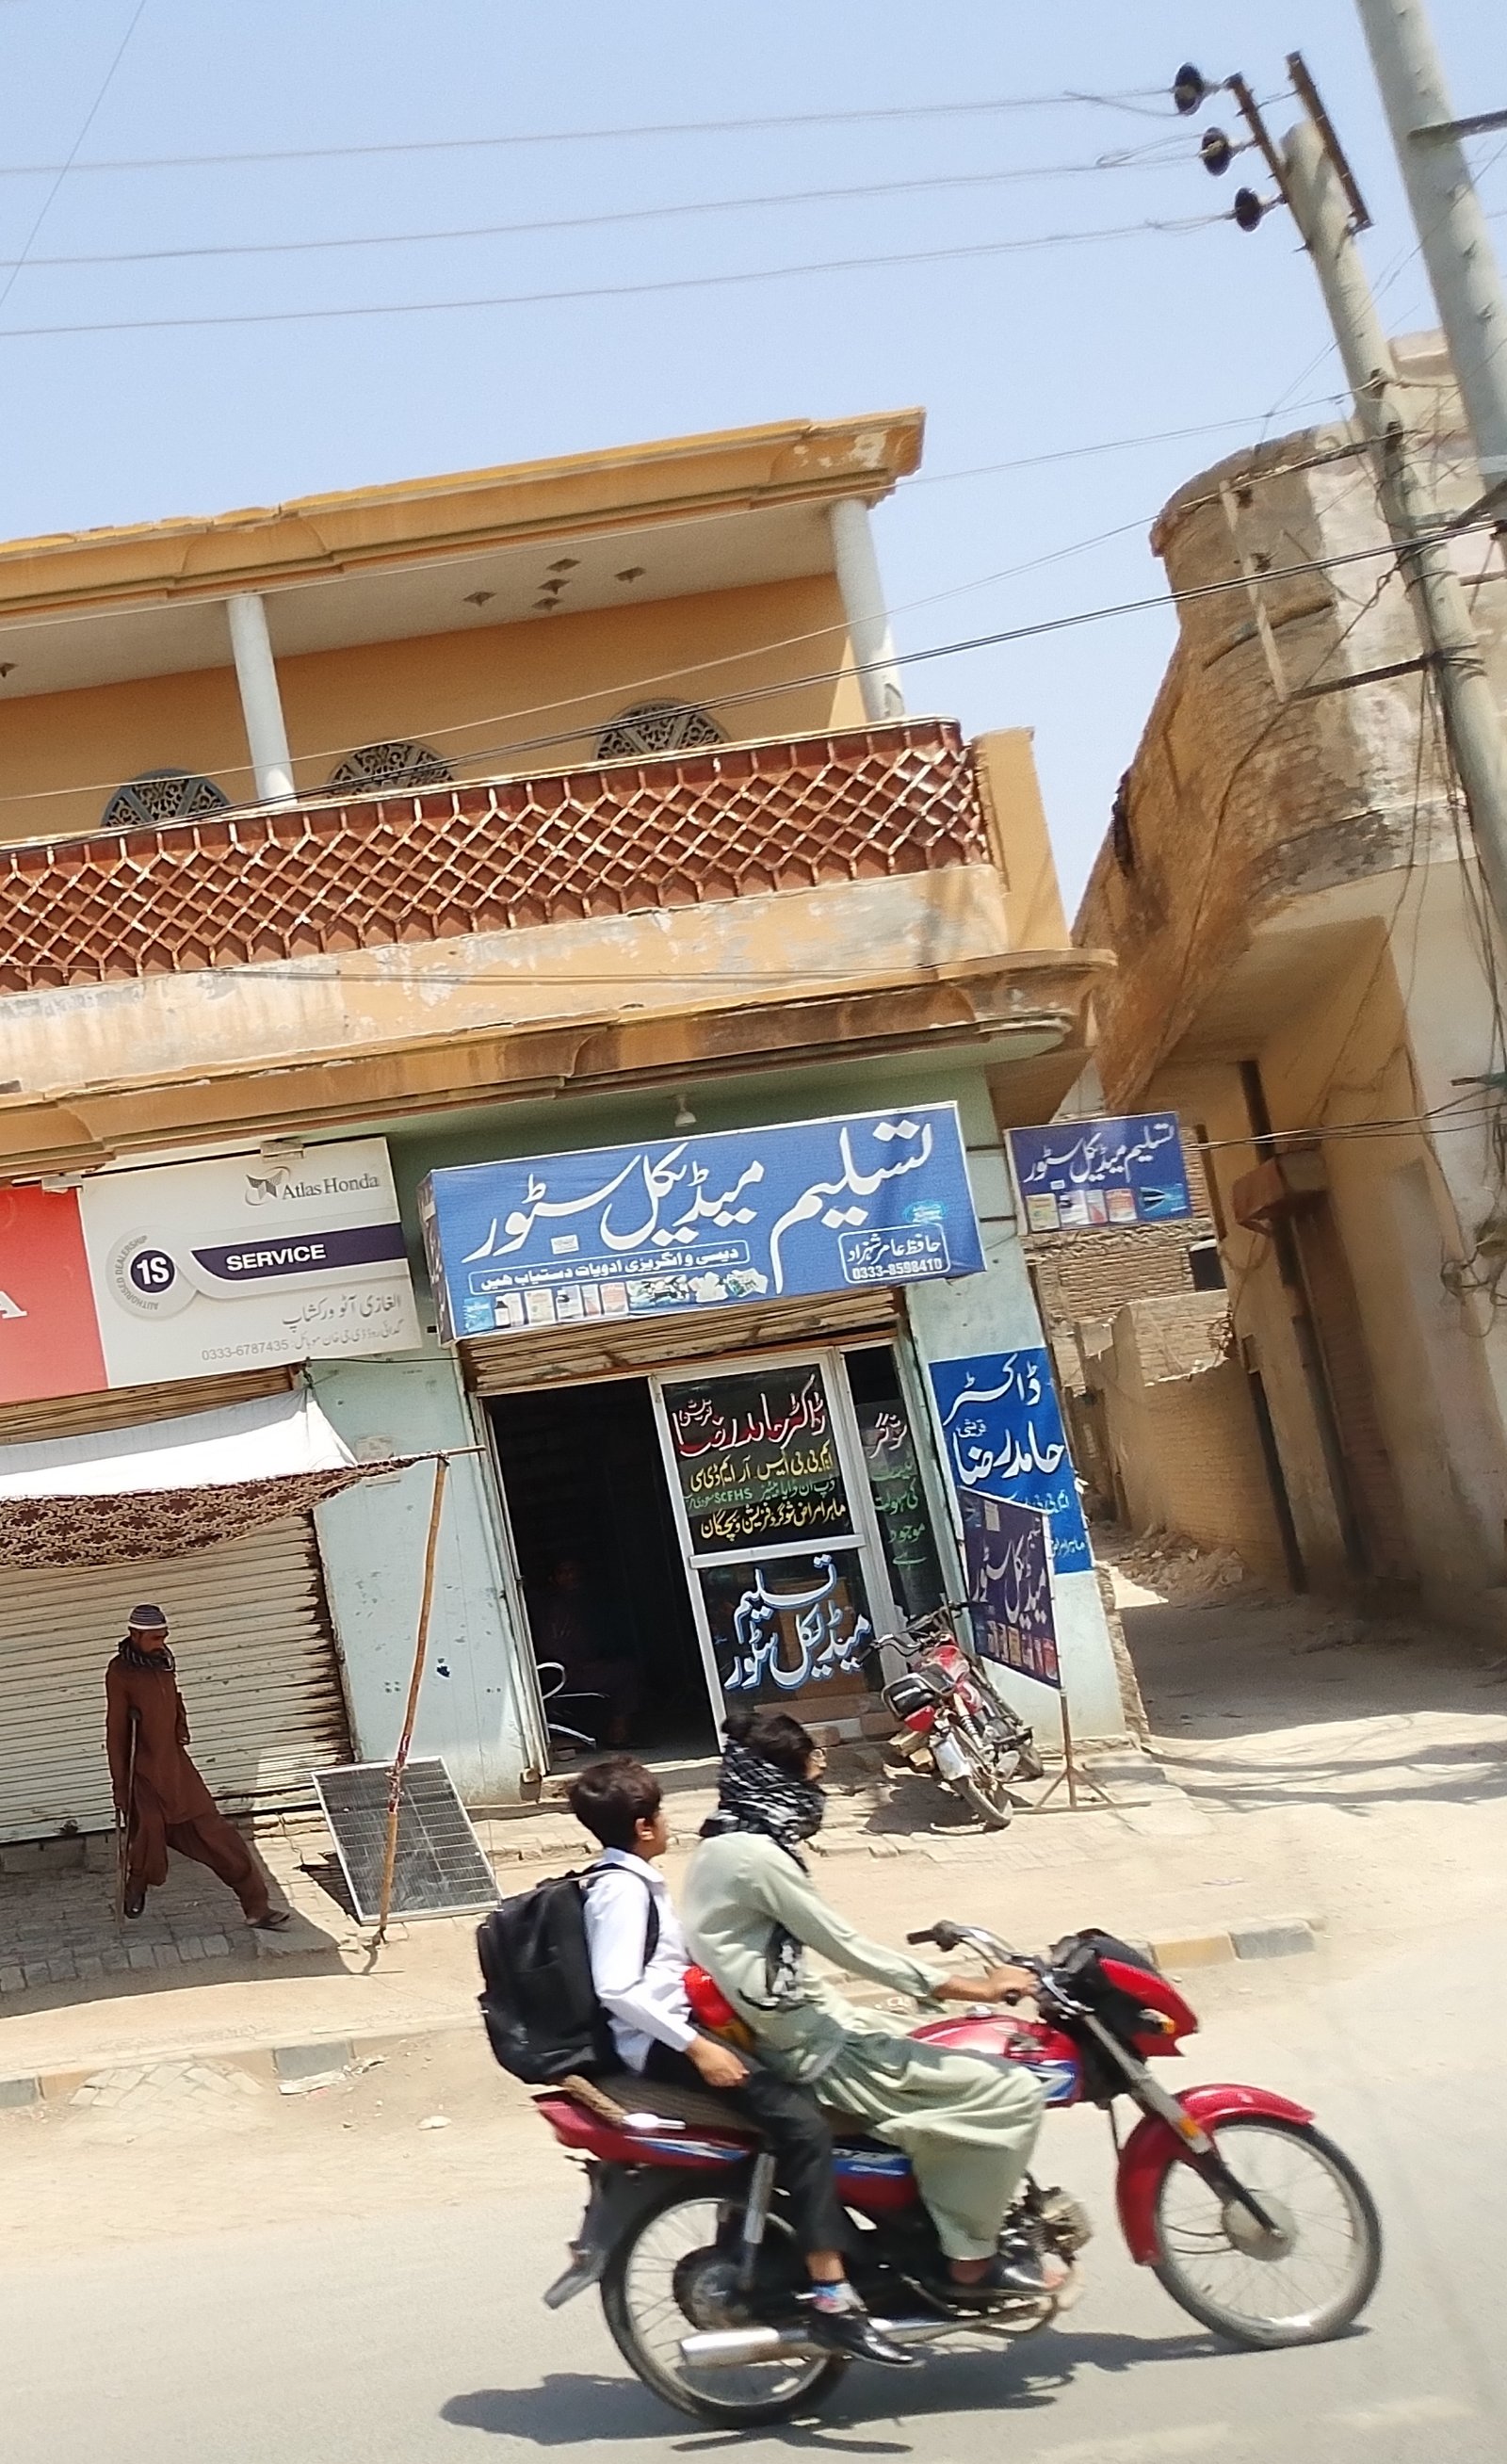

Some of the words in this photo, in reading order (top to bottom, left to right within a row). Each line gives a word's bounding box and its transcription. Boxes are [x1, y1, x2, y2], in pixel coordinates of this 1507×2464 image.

[1023, 1138, 1084, 1183] سٹور
[1070, 1132, 1127, 1183] میڈیکل
[1125, 1123, 1175, 1183] تسلیم
[283, 1177, 321, 1200] Atlas
[324, 1172, 380, 1192] Honda
[601, 1143, 765, 1252] میڈیکل
[462, 1154, 642, 1263] سٹور
[772, 1120, 932, 1295] تسلیم
[115, 1235, 148, 1275] DEALERSHIP
[226, 1244, 326, 1272] SERVICE
[696, 1246, 739, 1266] دیسی
[847, 1233, 882, 1266] شہزاد
[870, 1238, 907, 1266] عامر
[905, 1233, 942, 1256] حافظ
[137, 1256, 170, 1285] 1S
[514, 1268, 574, 1288] دستیاب
[575, 1259, 624, 1278] ادویات
[116, 1277, 159, 1310] AUTHORISED
[283, 1297, 334, 1333] ورکشاپ
[203, 1339, 289, 1361] 0333-6787435
[943, 1353, 1041, 1425] ڈاکٹر
[780, 1373, 826, 1451] ڈاکٹر
[952, 1429, 1011, 1485] رضا
[1001, 1420, 1065, 1480] حامد
[713, 1487, 754, 1504] SCFHS
[733, 1554, 837, 1644] تسلیم
[724, 1620, 778, 1691] سٹور
[770, 1600, 872, 1691] میڈیکل
